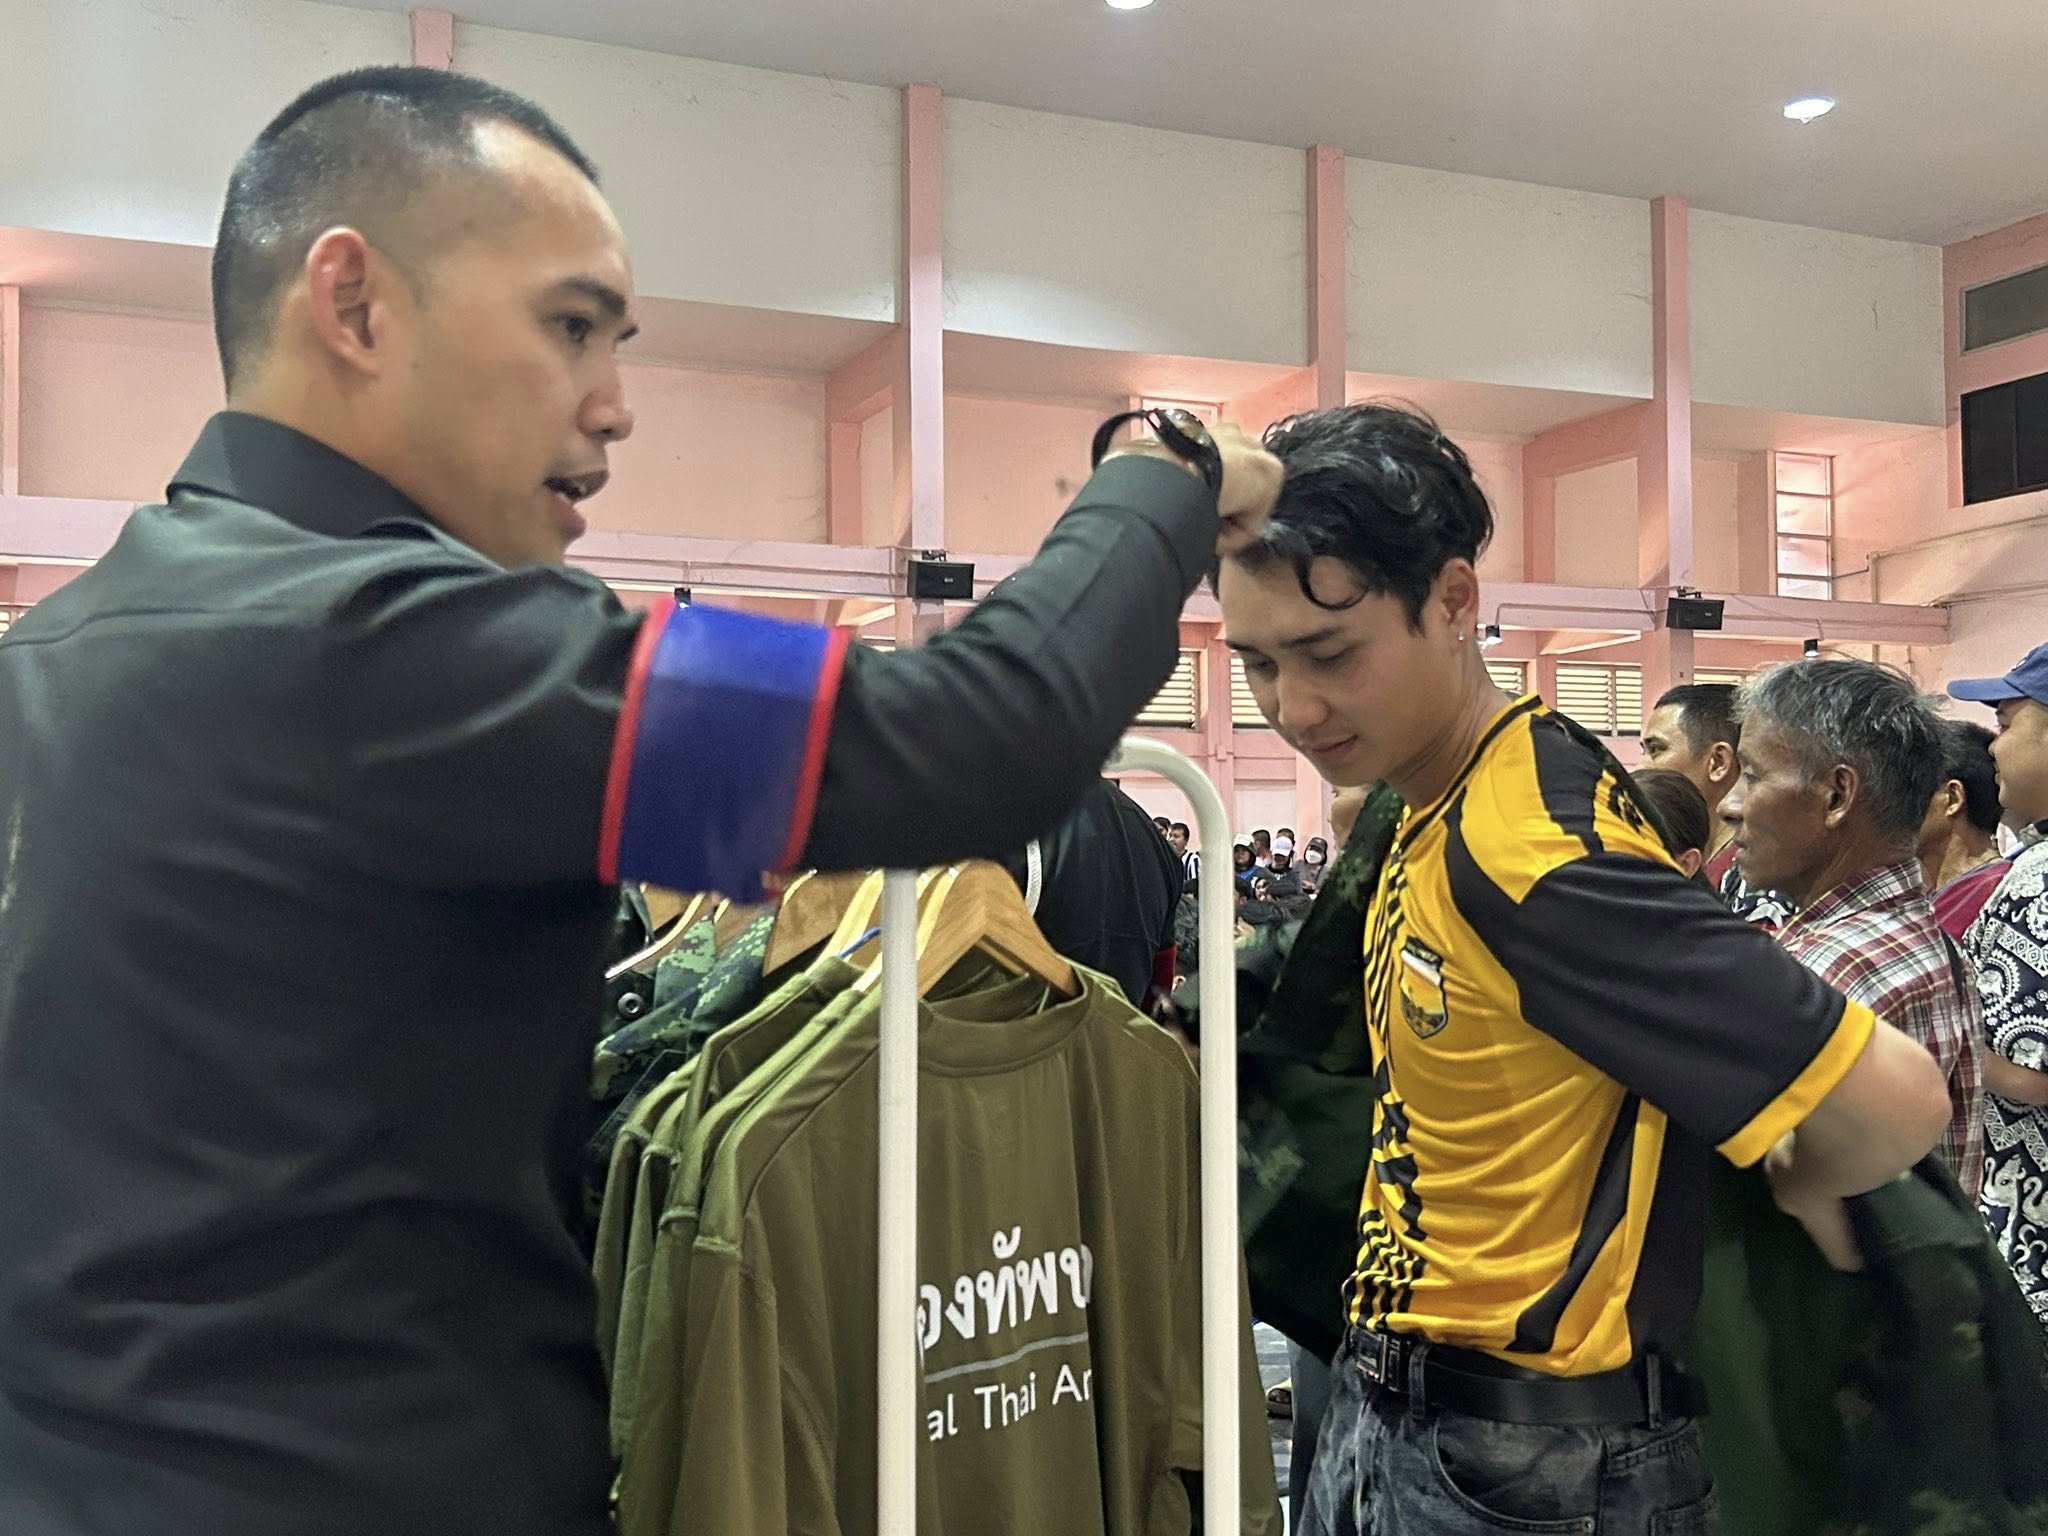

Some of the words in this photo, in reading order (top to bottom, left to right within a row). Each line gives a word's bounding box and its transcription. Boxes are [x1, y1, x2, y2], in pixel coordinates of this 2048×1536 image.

[916, 1226, 1093, 1368] องทัพบ
[926, 1393, 958, 1442] al
[974, 1371, 1036, 1430] Thai
[1051, 1364, 1092, 1405] Ar
